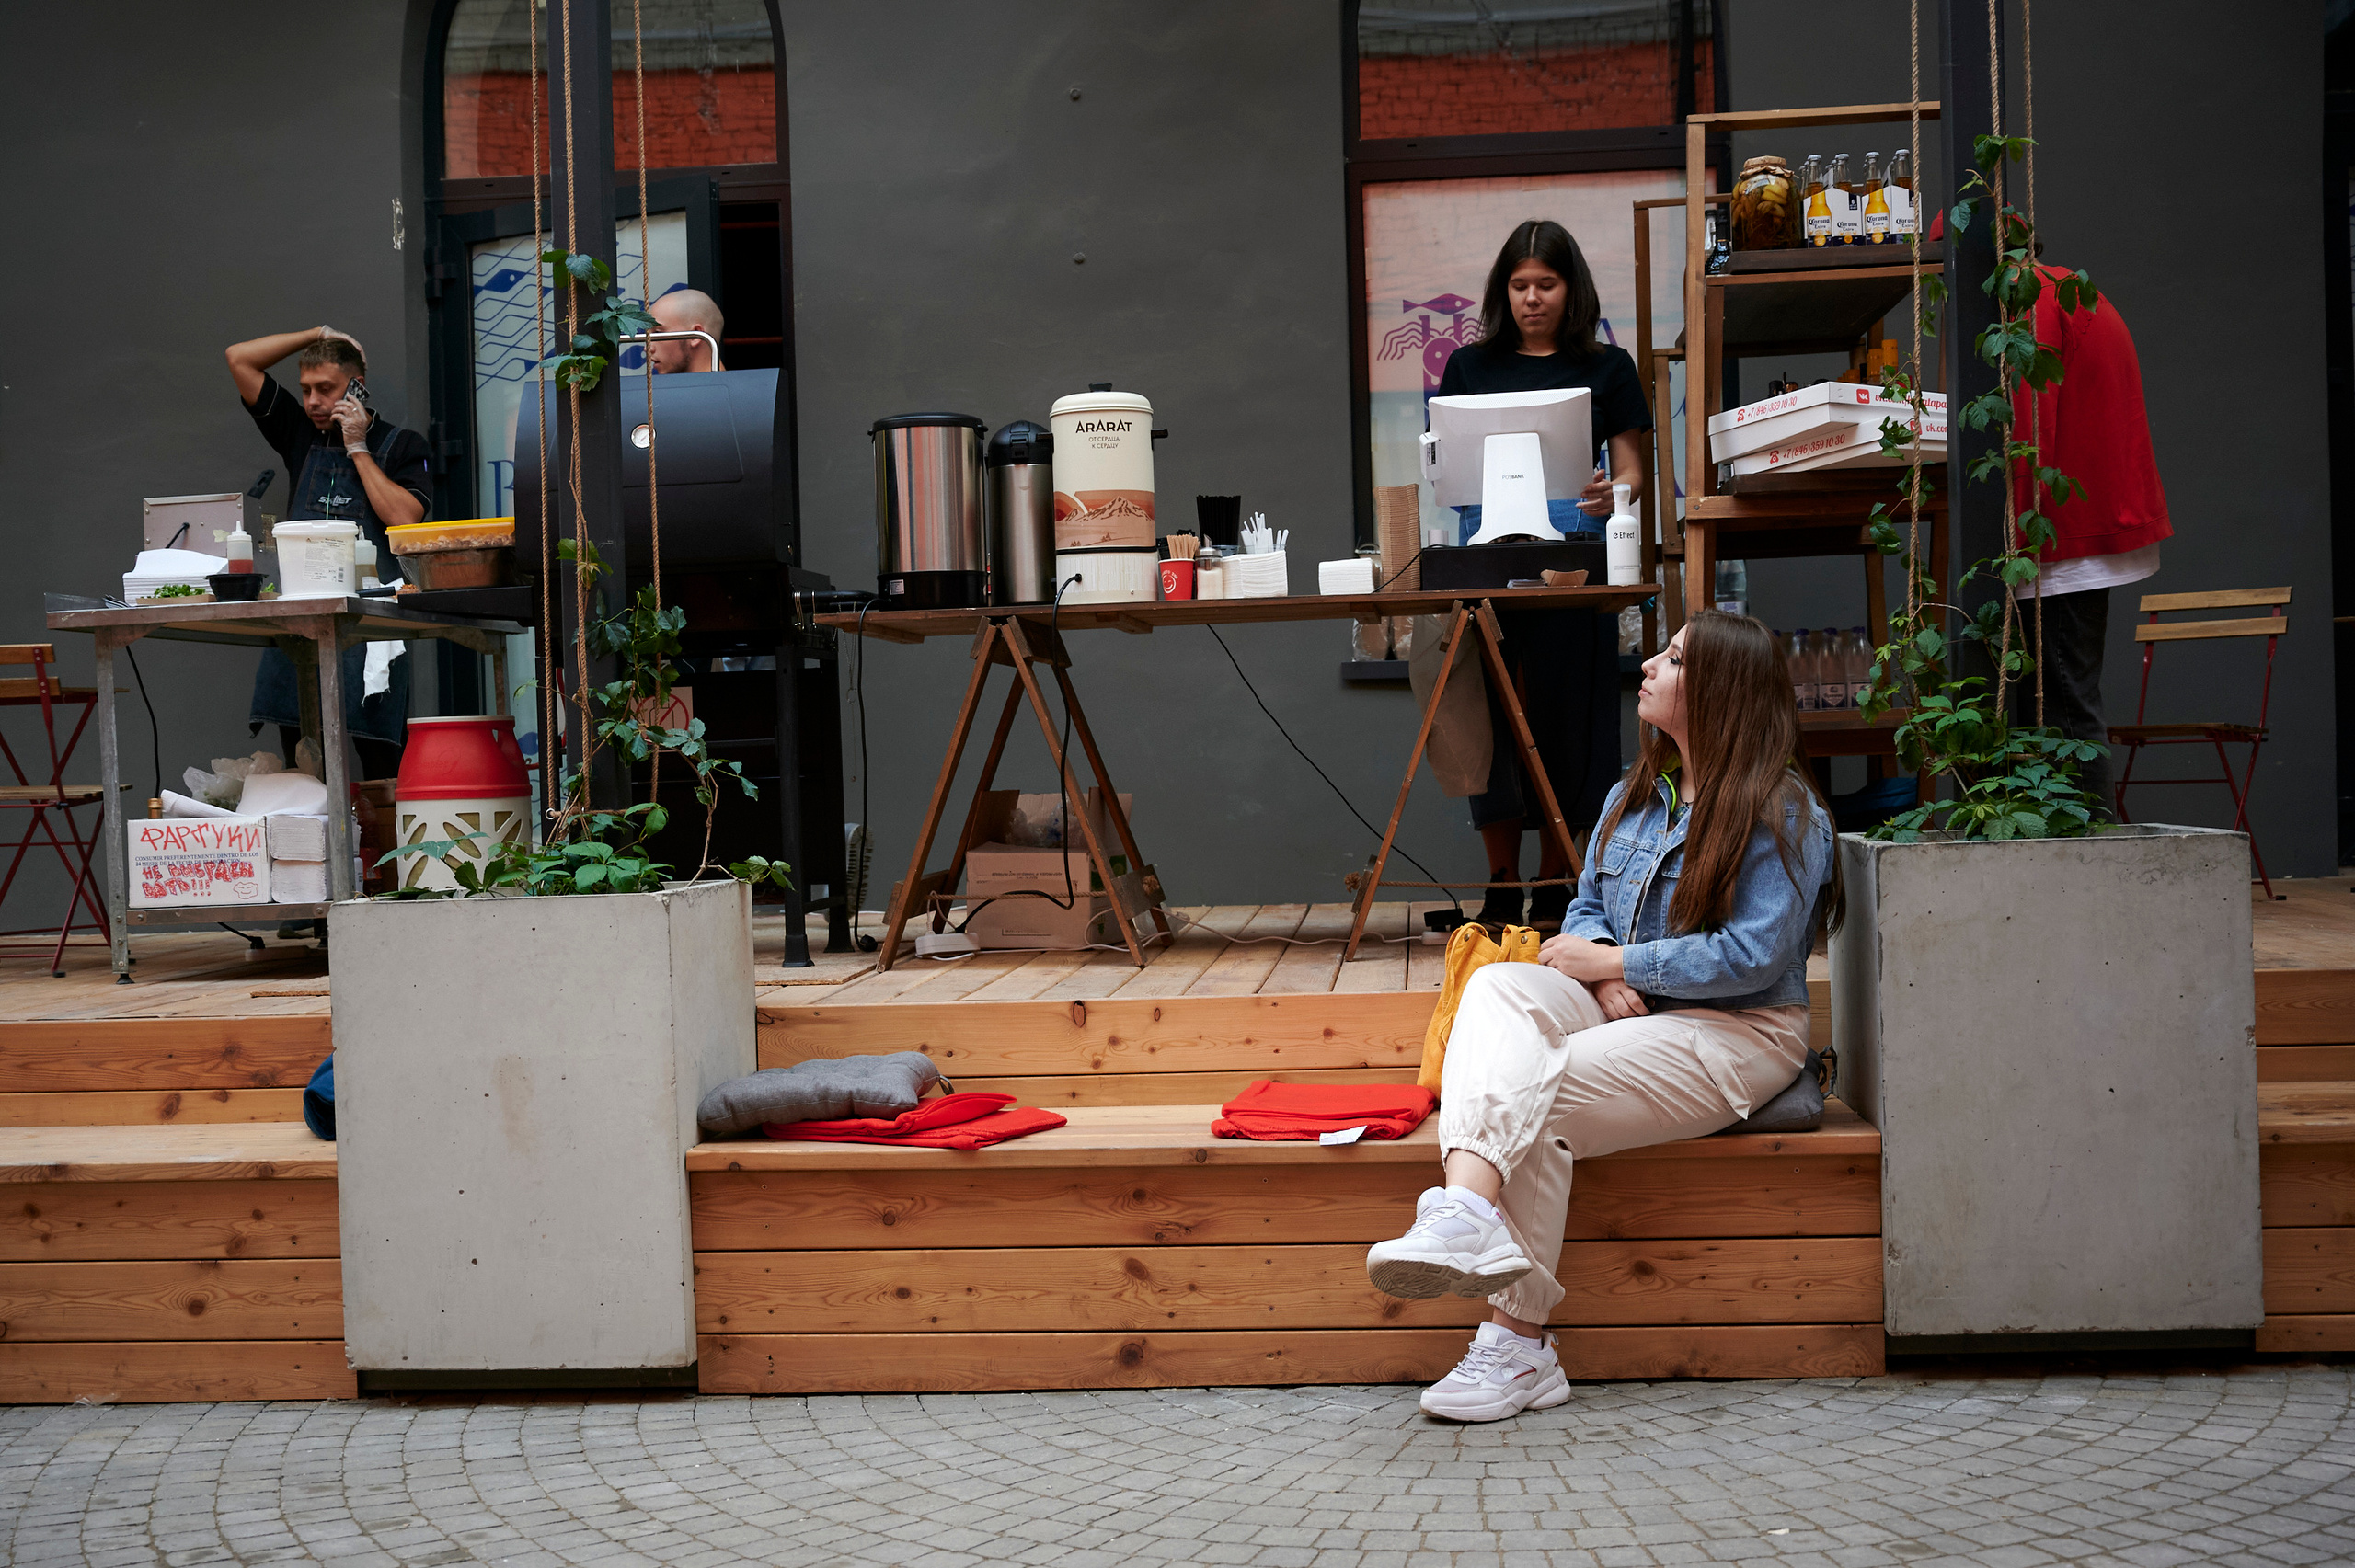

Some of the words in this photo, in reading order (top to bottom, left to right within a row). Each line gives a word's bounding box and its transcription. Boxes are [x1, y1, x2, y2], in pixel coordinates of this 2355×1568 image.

[1075, 418, 1132, 433] ARARAT
[1826, 437, 1834, 448] 10
[1834, 433, 1845, 445] 30
[140, 822, 261, 852] ФАРТУКИ
